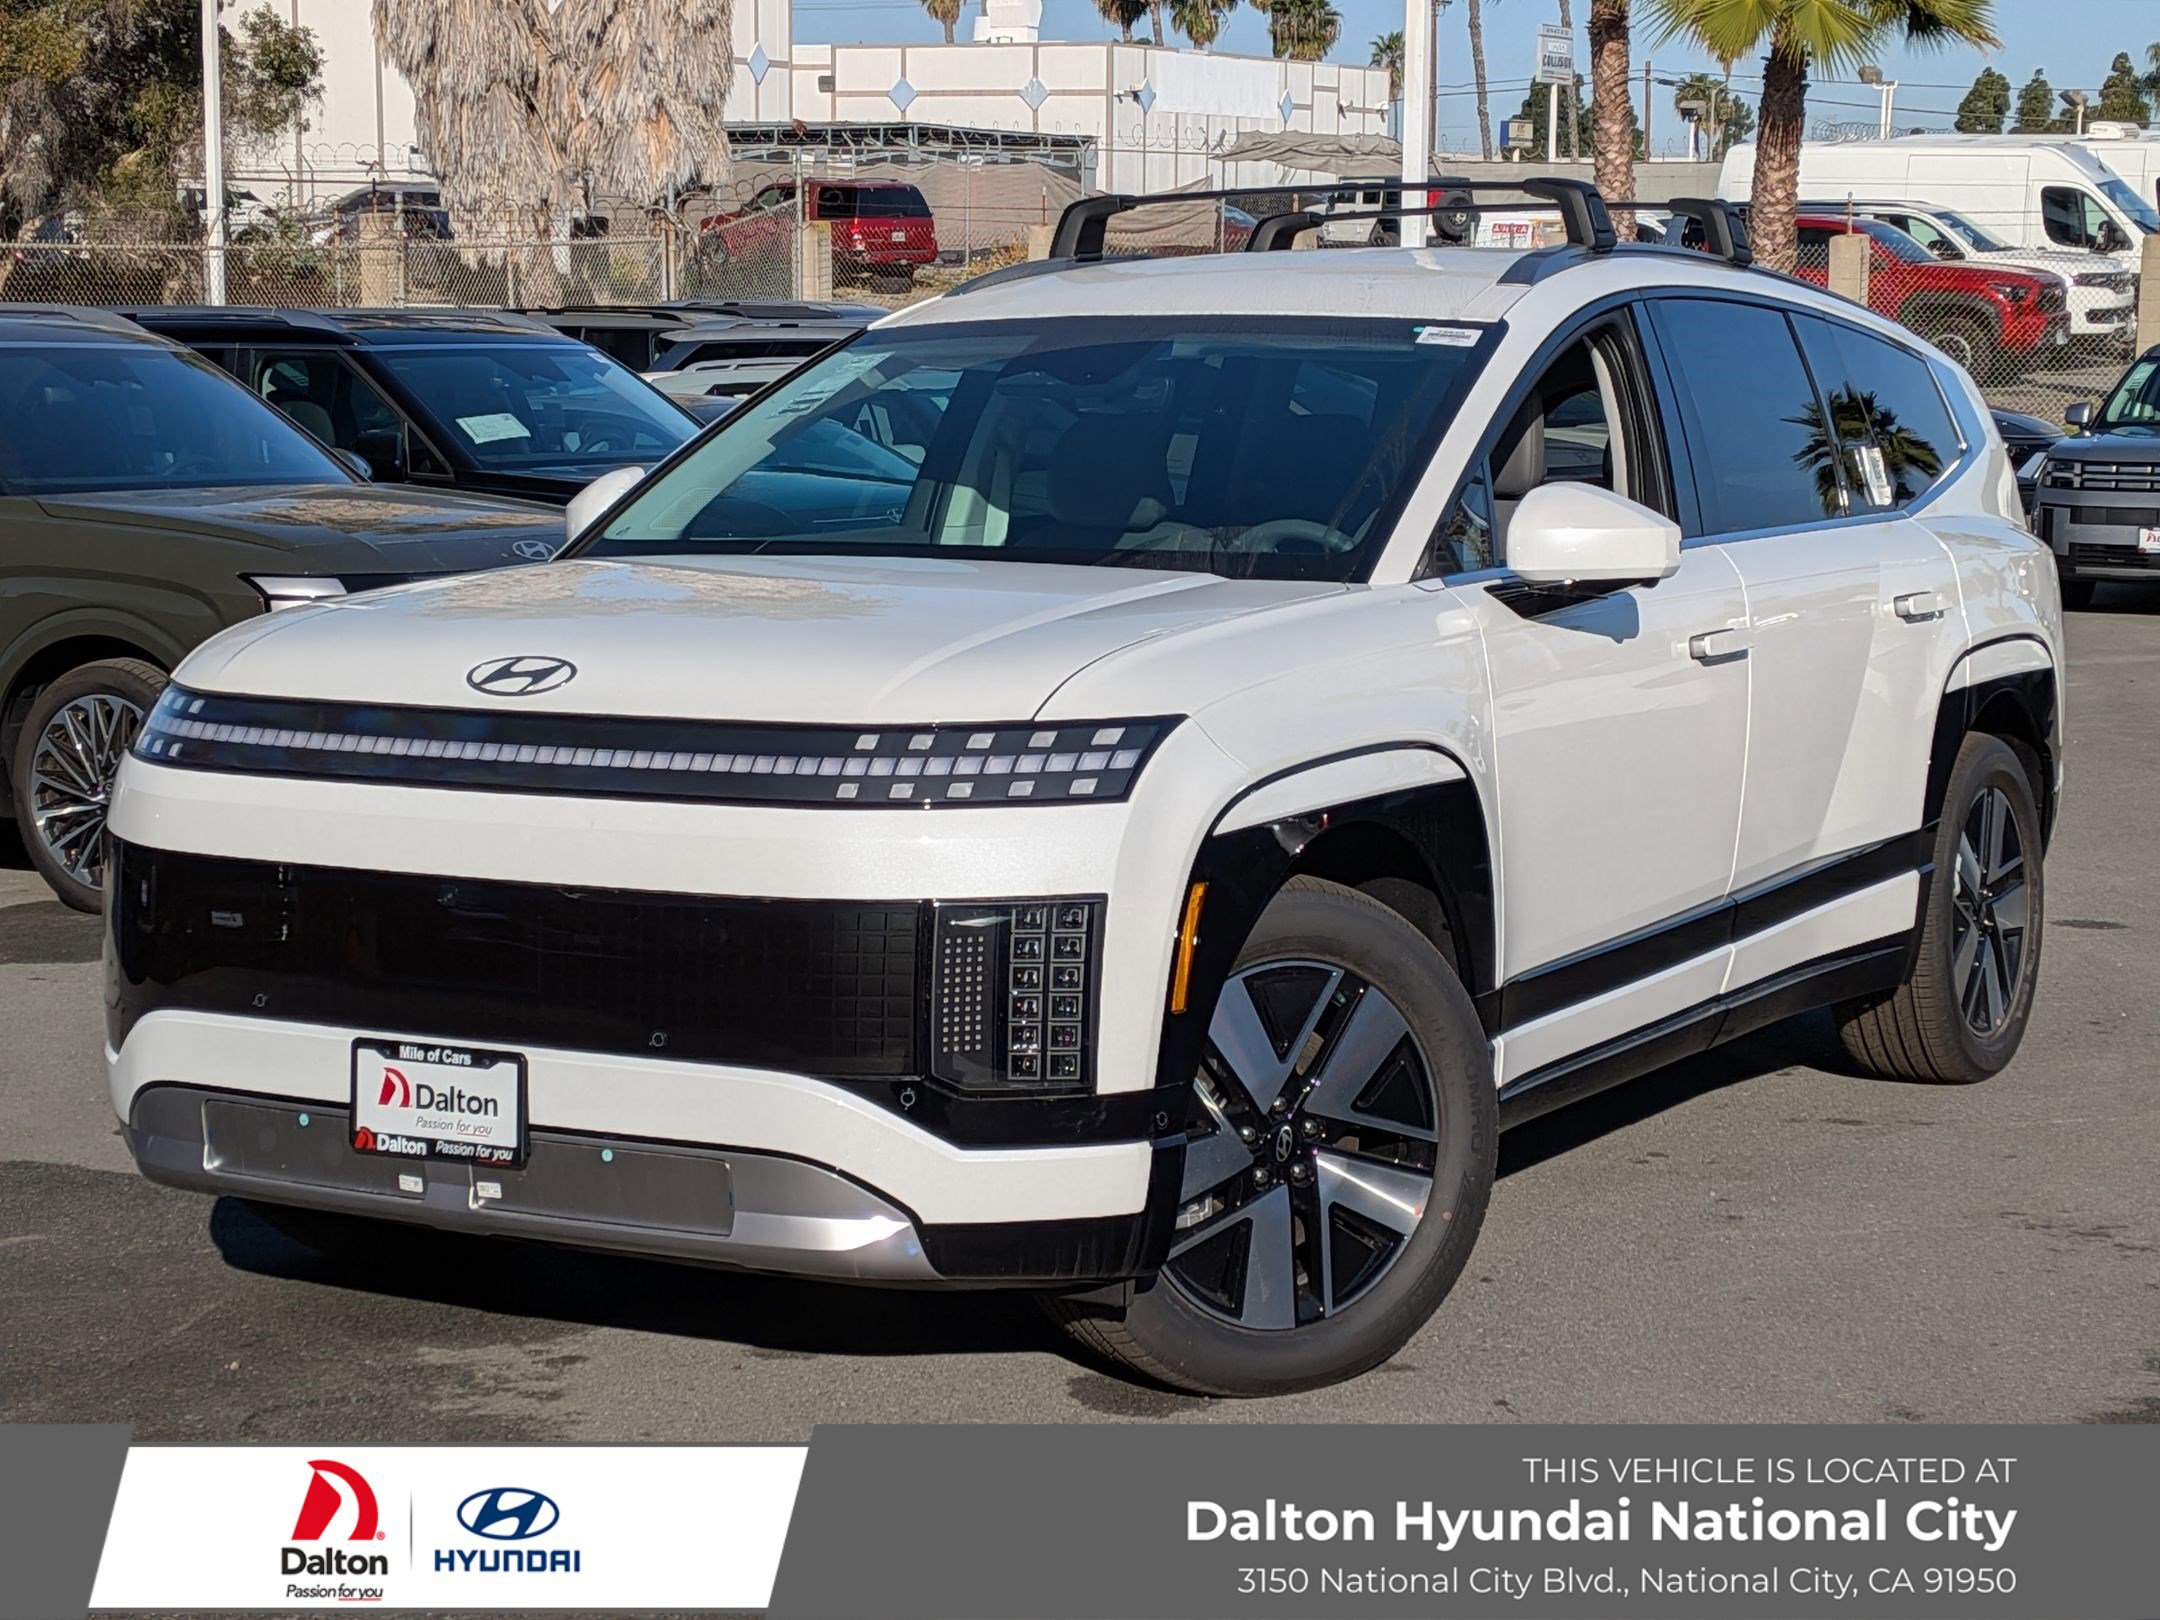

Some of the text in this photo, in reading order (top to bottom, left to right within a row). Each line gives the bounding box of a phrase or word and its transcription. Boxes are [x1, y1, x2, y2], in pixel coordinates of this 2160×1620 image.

[399, 1045, 472, 1066] Mile of Cars
[415, 1083, 498, 1117] Dalton
[415, 1116, 493, 1136] Passion for you
[376, 1134, 427, 1156] Dalton
[435, 1140, 513, 1161] Passion for you
